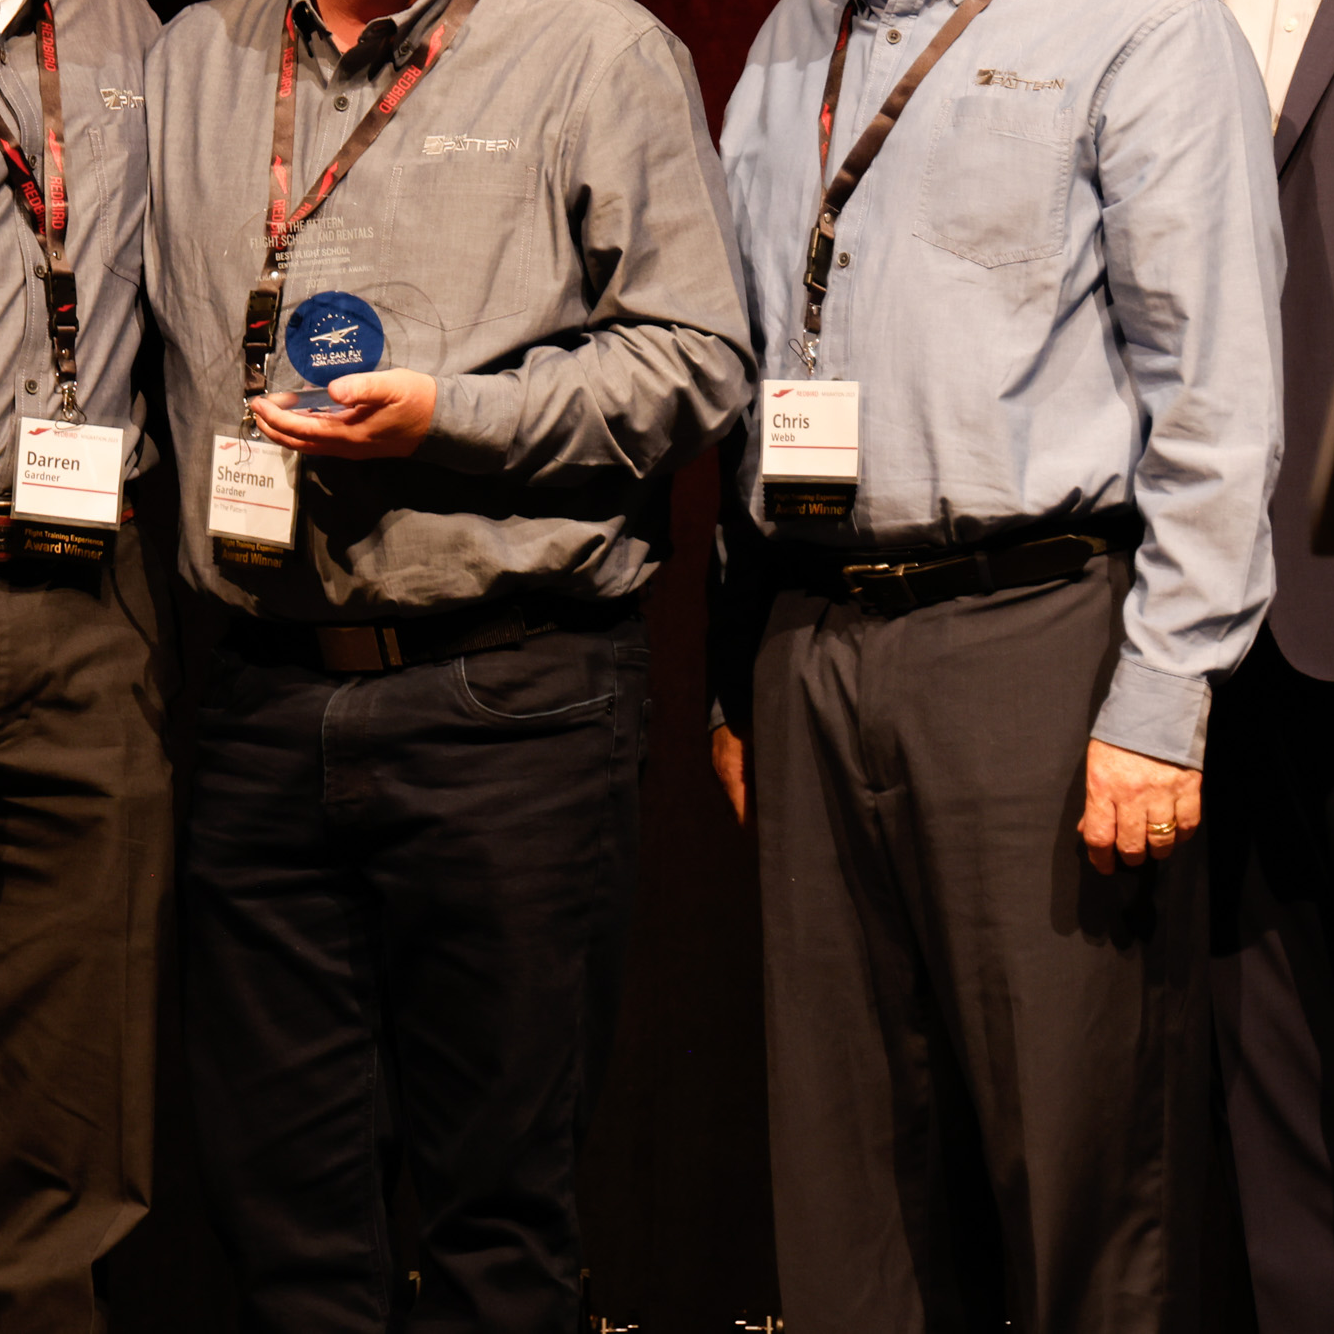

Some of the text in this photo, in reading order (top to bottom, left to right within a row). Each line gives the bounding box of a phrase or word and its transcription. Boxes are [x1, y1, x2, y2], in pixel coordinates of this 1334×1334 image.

[41, 21, 57, 72] REDBIRD
[279, 46, 294, 98] REDBIRD
[378, 64, 422, 114] REDBIRD
[443, 137, 520, 153] PATTERN
[49, 175, 65, 229] REDBIRD
[289, 220, 305, 233] THE
[250, 227, 374, 249] FLIGHT SCHOOL AND RENTALS
[275, 251, 293, 262] BEST
[322, 246, 351, 257] SCHOOL
[310, 349, 362, 362] YOU CAN FLY
[772, 413, 810, 429] Chris
[771, 432, 796, 442] Webb
[26, 450, 80, 471] Darren
[24, 469, 61, 482] Gardner
[217, 465, 274, 489] Sherman
[215, 484, 246, 498] Gardner
[44, 531, 69, 542] Training
[24, 539, 103, 561] Award Winner
